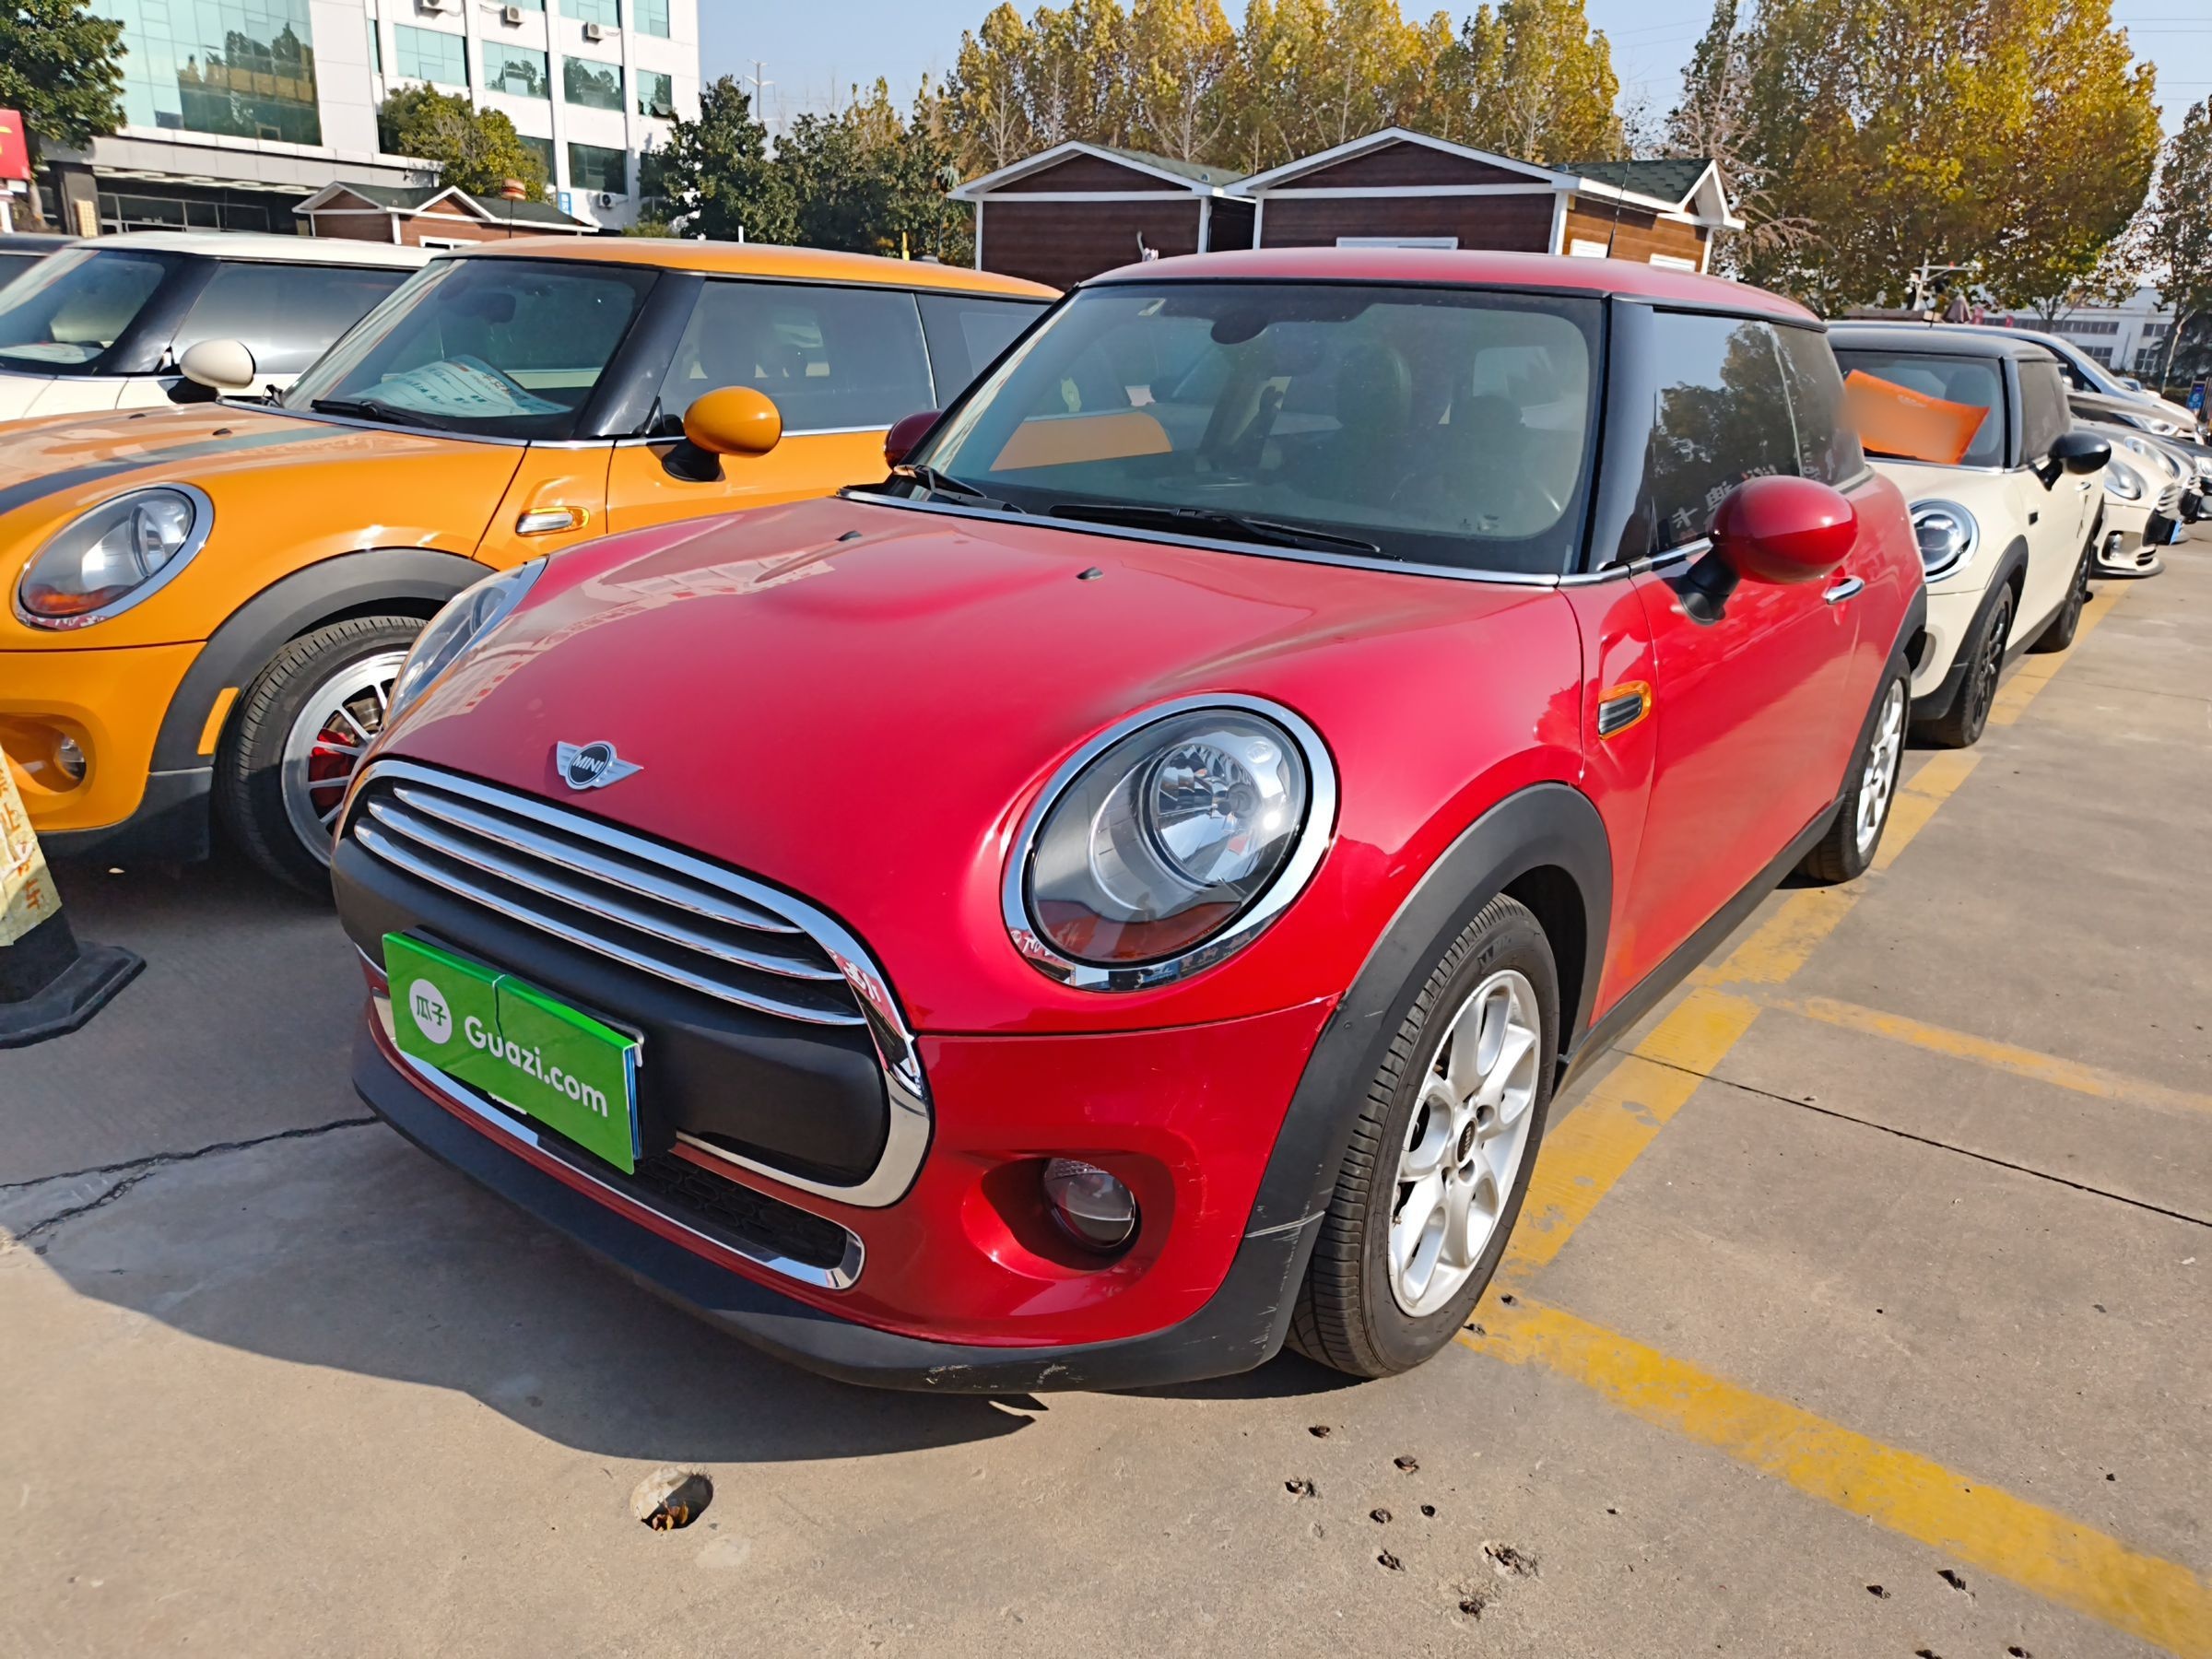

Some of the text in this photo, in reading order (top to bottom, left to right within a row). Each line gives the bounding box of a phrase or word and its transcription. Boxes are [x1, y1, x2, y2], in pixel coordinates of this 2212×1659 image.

[572, 754, 605, 773] MINI
[416, 994, 447, 1027] 瓜子
[464, 1016, 608, 1117] Guazi.com
